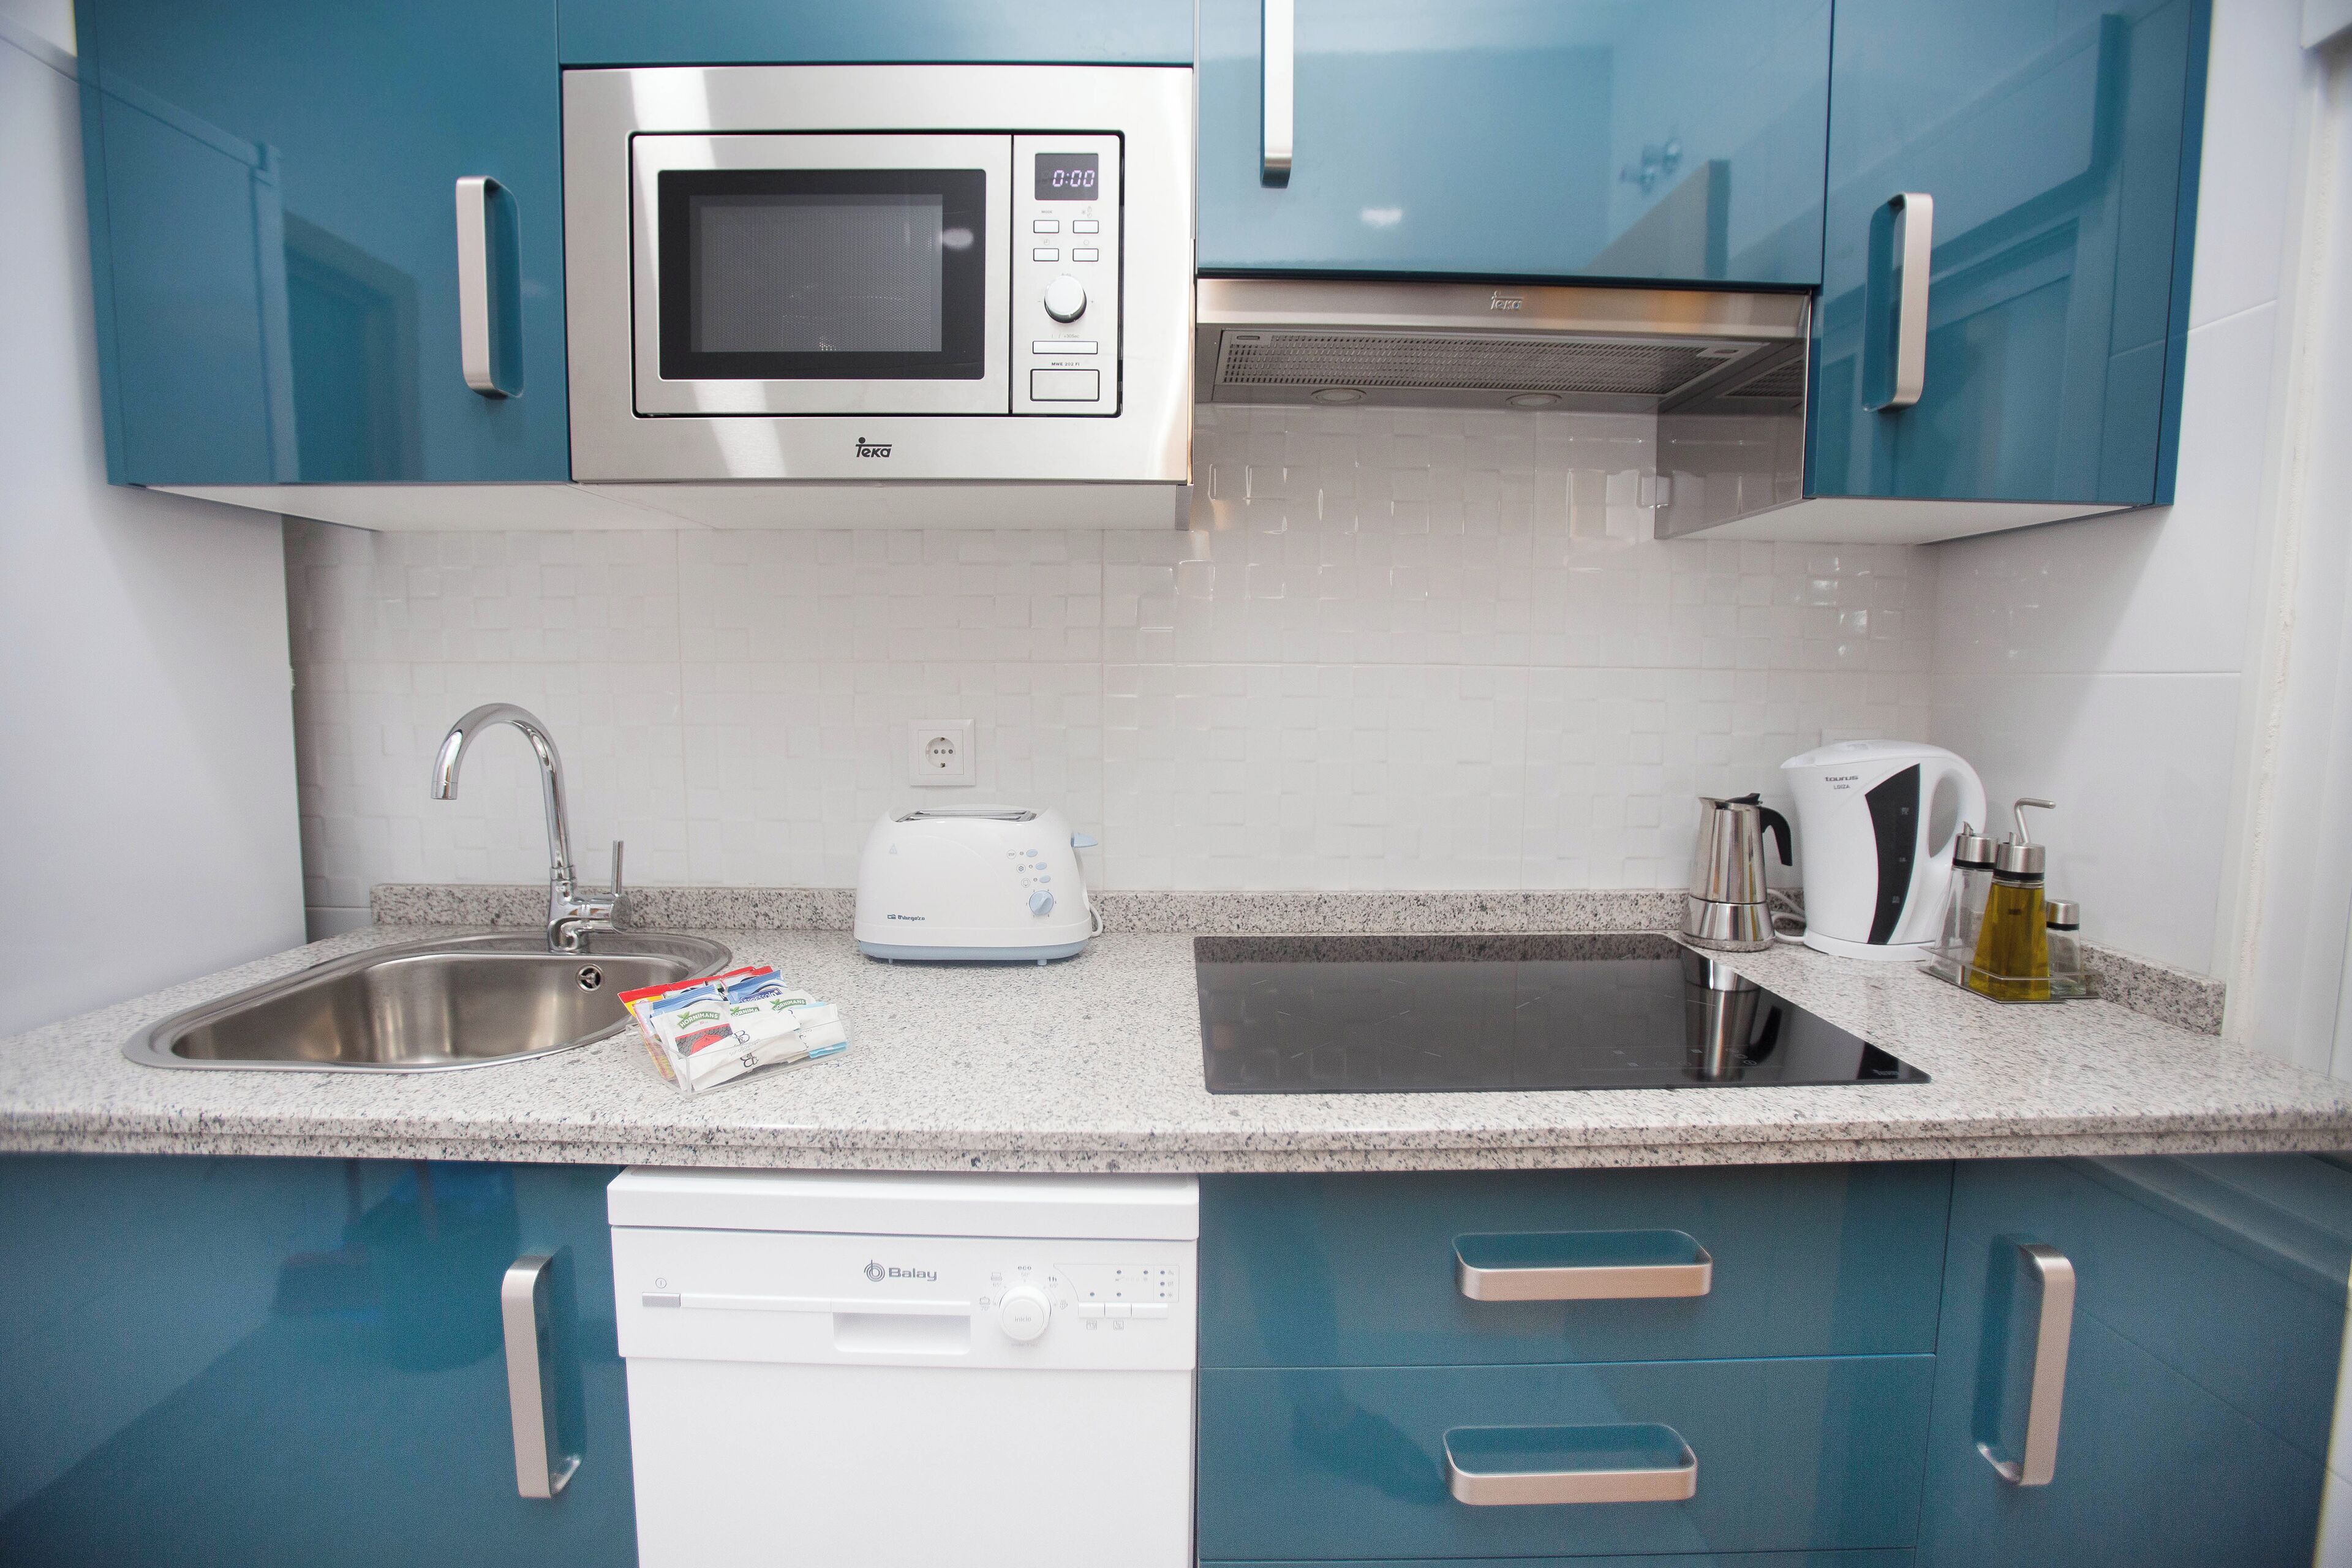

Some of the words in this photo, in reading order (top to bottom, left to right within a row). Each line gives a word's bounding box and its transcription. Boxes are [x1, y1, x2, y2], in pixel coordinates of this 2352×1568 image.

[1052, 170, 1095, 187] 0:00
[773, 1000, 805, 1011] HORNIMANS
[679, 1012, 718, 1028] HORNIMANS
[889, 1267, 937, 1281] Balay
